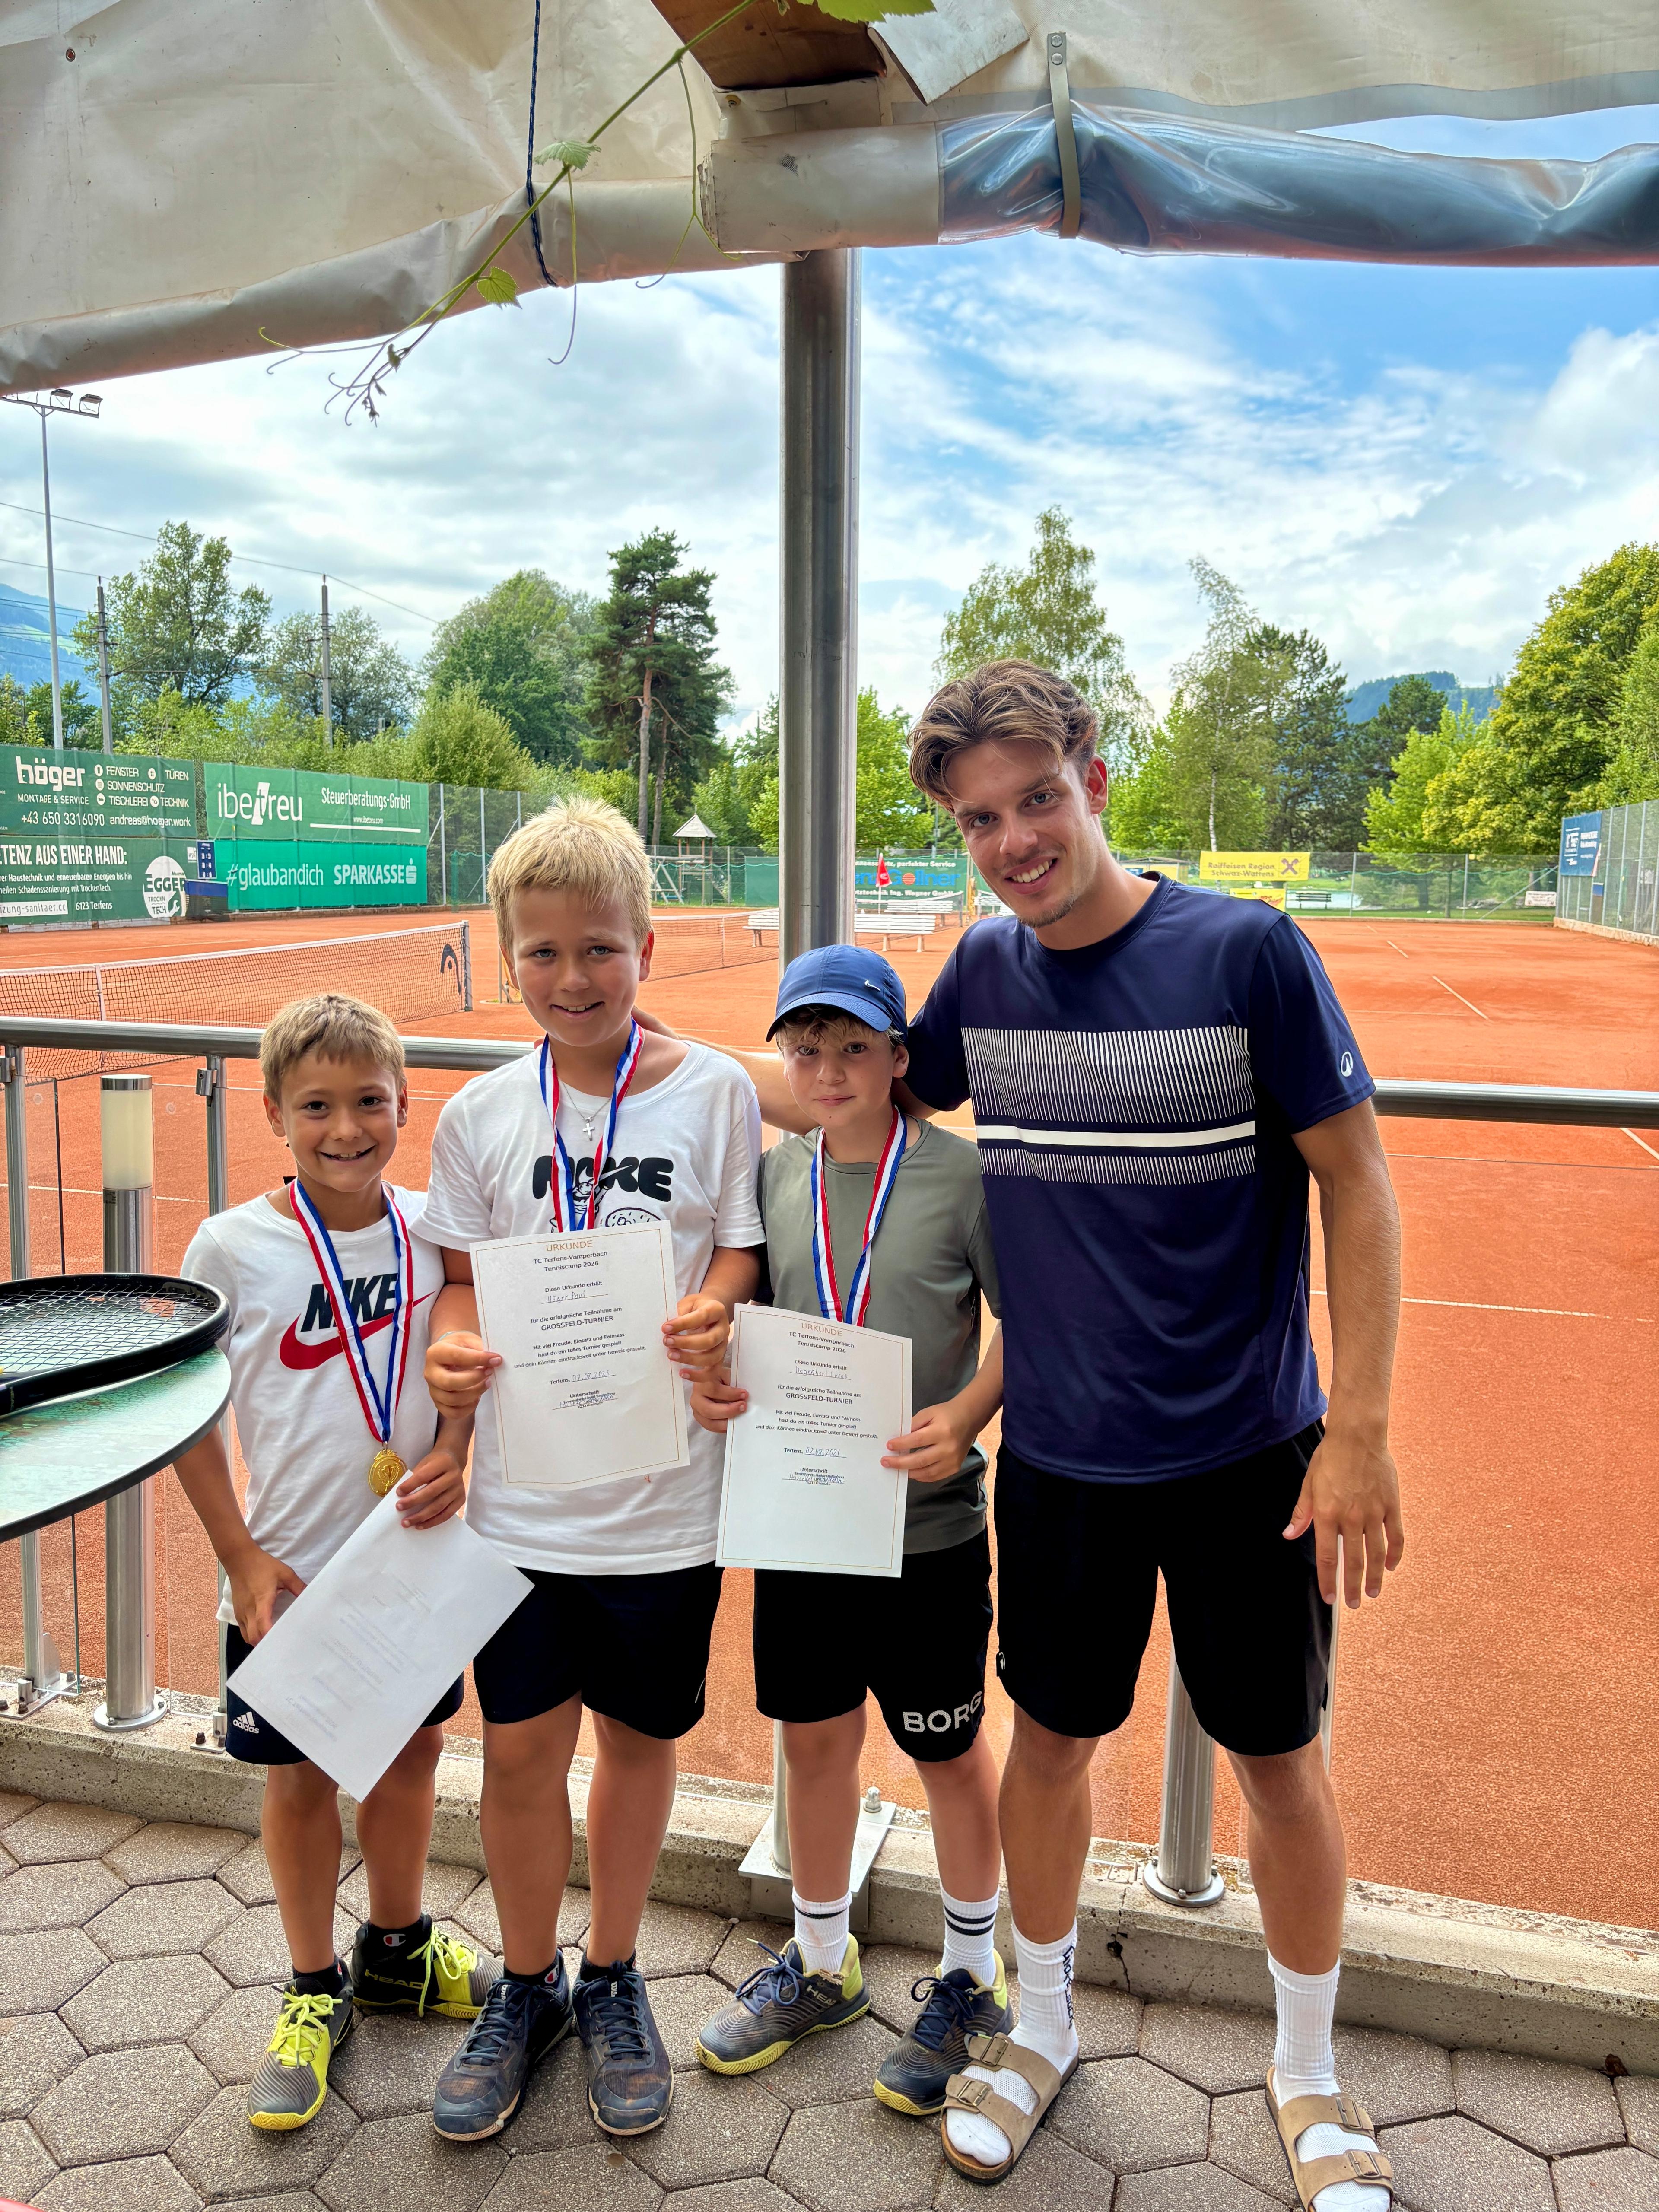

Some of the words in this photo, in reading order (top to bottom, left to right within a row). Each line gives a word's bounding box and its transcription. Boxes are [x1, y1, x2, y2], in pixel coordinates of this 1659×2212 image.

[16, 756, 85, 791] höger
[106, 766, 139, 777] FENSTER
[165, 769, 189, 781] TÜREN
[107, 780, 165, 793] SONNENSCHUTZ
[17, 793, 51, 804] MONTAGE
[53, 795, 59, 804] &
[60, 795, 89, 805] SERVICE
[108, 795, 148, 806] TISCHLEREI
[160, 797, 189, 807] TECHNIK
[321, 786, 410, 811] Steuerberatungs-GmbH
[21, 810, 39, 824] +43
[42, 811, 60, 825] 650
[64, 812, 105, 826] 3316090
[36, 845, 58, 865] AUS
[60, 845, 93, 865] EINER
[95, 845, 127, 865] HAND:
[8, 873, 43, 882] Haustechnik
[44, 873, 55, 881] und
[56, 872, 92, 881] erneuerbaren
[94, 873, 115, 882] Energien
[144, 874, 185, 893] EGGER
[226, 863, 324, 891] #glaubandich
[334, 864, 404, 885] SPARKASSE
[18, 885, 70, 894] Schadenssanierung
[76, 901, 89, 911] 6123
[90, 900, 113, 910] Terfens
[152, 906, 166, 914] TECH
[546, 1240, 593, 1252] URKUNDE
[543, 1251, 608, 1263] Terfens-Vomperbach
[544, 1263, 582, 1272] Tenniscamp
[541, 1316, 614, 1331] GROSSFELD-TURNIER
[550, 1313, 583, 1321] erfolgreiche
[801, 1322, 843, 1337] URKUNDE
[798, 1333, 855, 1348] Terfens-Vomperbach
[798, 1341, 831, 1351] Tenniscamp
[558, 1353, 591, 1362] eindrucksvoll
[569, 1390, 600, 1398] Unterschrift
[786, 1392, 853, 1405] GROSSFELD-TURNIER
[903, 1691, 982, 1733] BORG
[233, 1719, 259, 1734] adidas
[365, 1969, 424, 1990] HEAD
